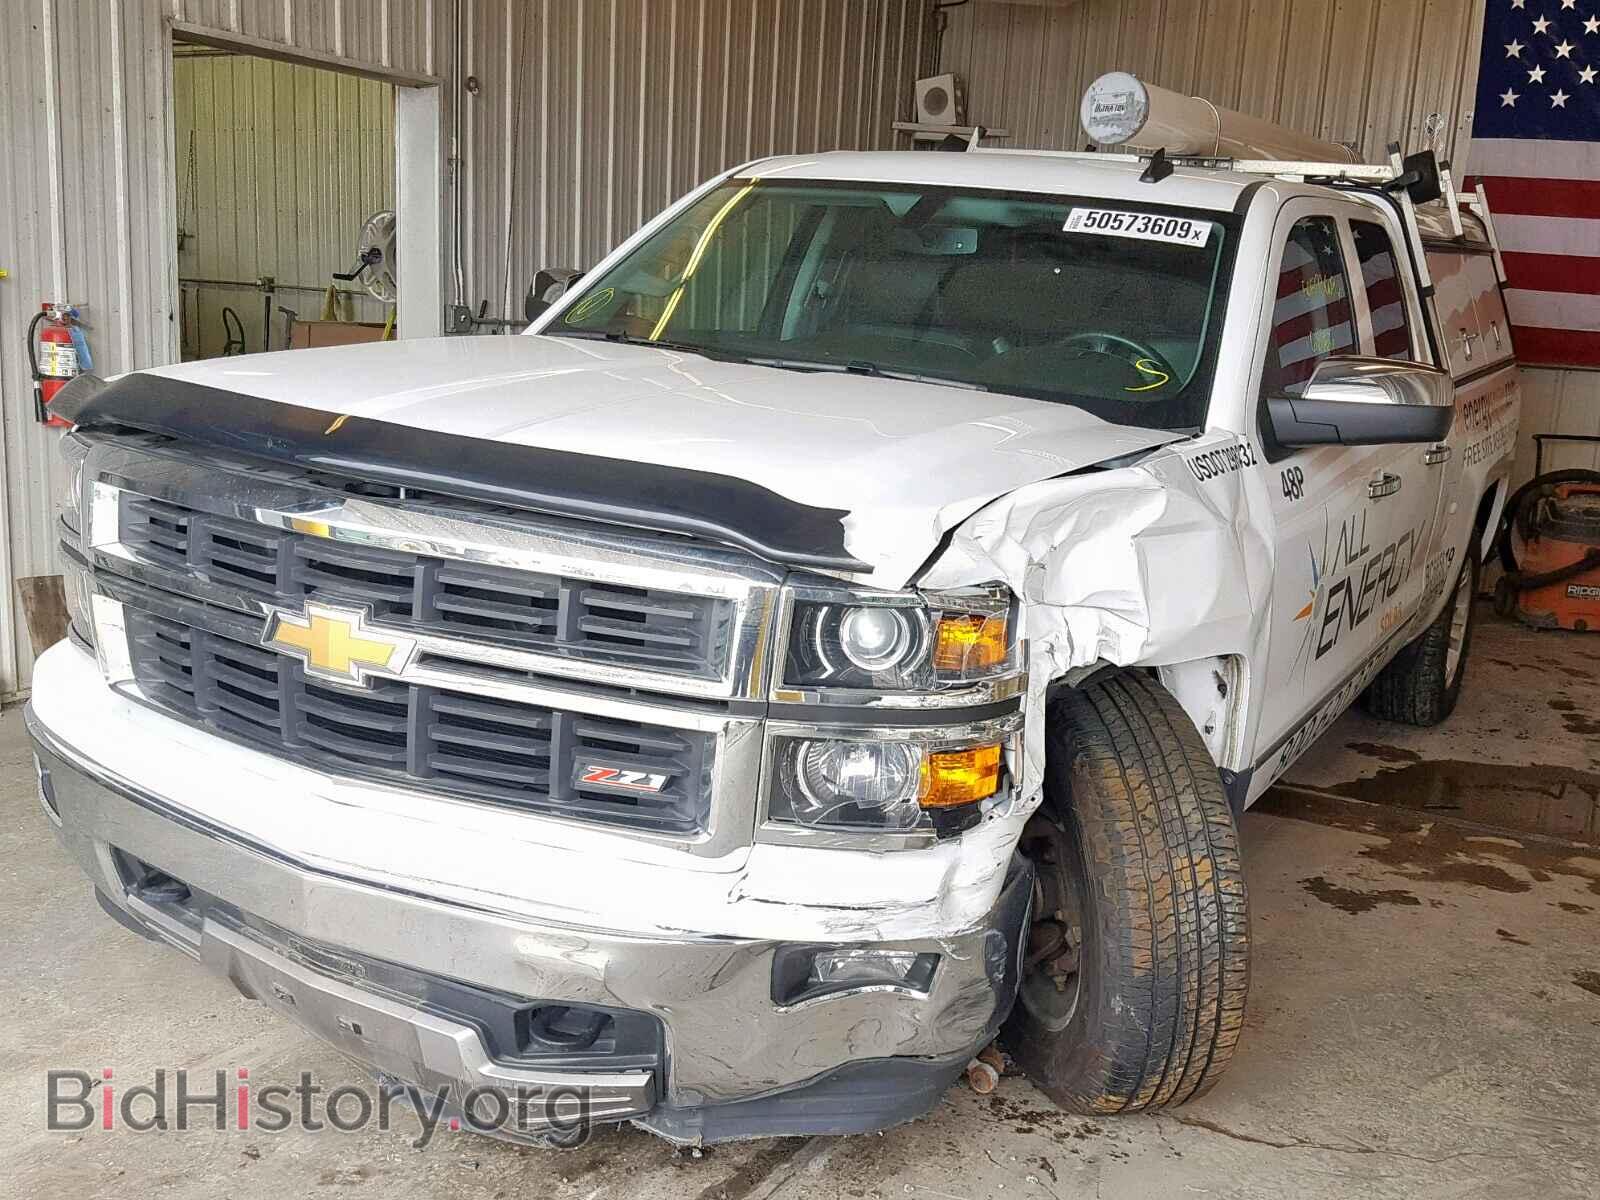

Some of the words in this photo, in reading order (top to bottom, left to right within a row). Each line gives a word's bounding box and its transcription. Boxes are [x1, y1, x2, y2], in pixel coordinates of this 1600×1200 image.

[1280, 466, 1304, 502] 48P
[1331, 508, 1370, 577] ALL
[1314, 519, 1426, 661] ENERGY
[581, 765, 667, 792] Z71
